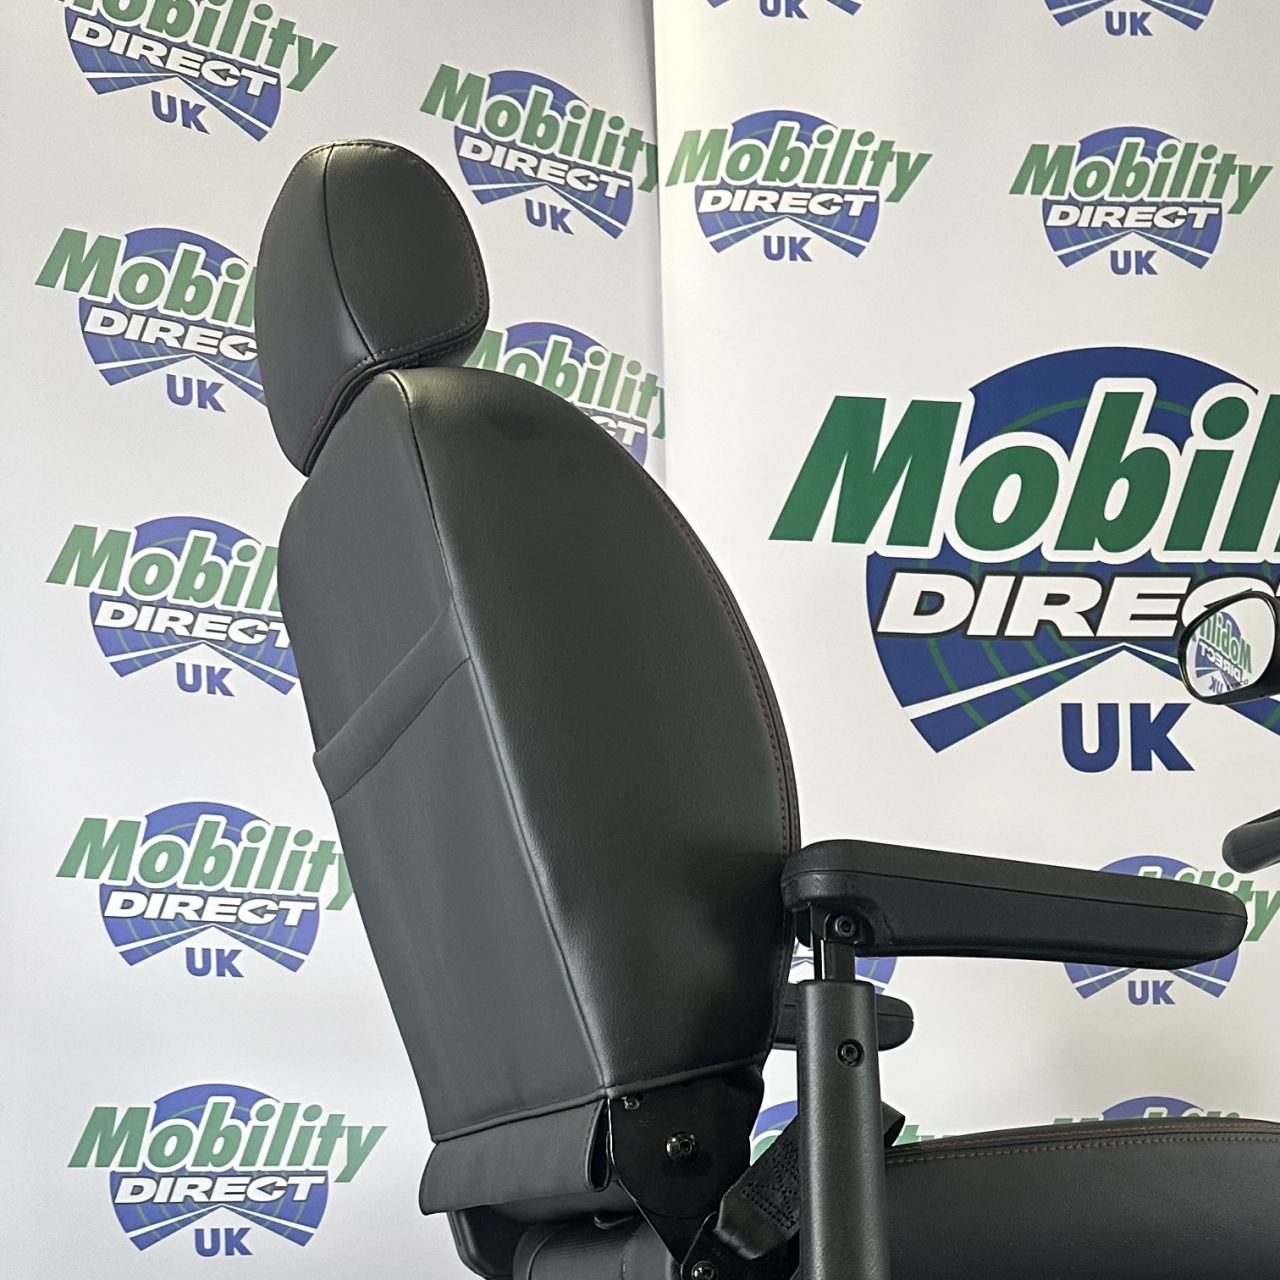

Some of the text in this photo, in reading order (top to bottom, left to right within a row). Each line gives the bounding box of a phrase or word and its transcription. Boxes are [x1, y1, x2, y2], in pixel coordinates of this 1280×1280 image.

[759, 0, 808, 19] UK
[1105, 11, 1153, 36] UK
[70, 17, 278, 97] DIRECT
[151, 90, 210, 134] UK
[459, 135, 630, 199] DIRECT
[666, 123, 933, 203] Mobility
[1009, 139, 1274, 214] Mobility
[525, 199, 574, 235] UK
[699, 188, 878, 218] DIRECT
[1045, 204, 1222, 229] DIRECT
[763, 236, 812, 262] UK
[1110, 250, 1158, 275] UK
[84, 307, 258, 361] DIREC
[166, 374, 225, 412] UK
[46, 524, 281, 612] Mobil
[176, 662, 235, 697] UK
[1061, 703, 1195, 773] UK
[104, 891, 316, 926] DIRECT
[186, 947, 244, 977] UK
[1128, 980, 1176, 1005] UK
[68, 1103, 387, 1182] Mobility
[115, 1175, 329, 1204] DIRECT
[194, 1228, 253, 1256] UK
